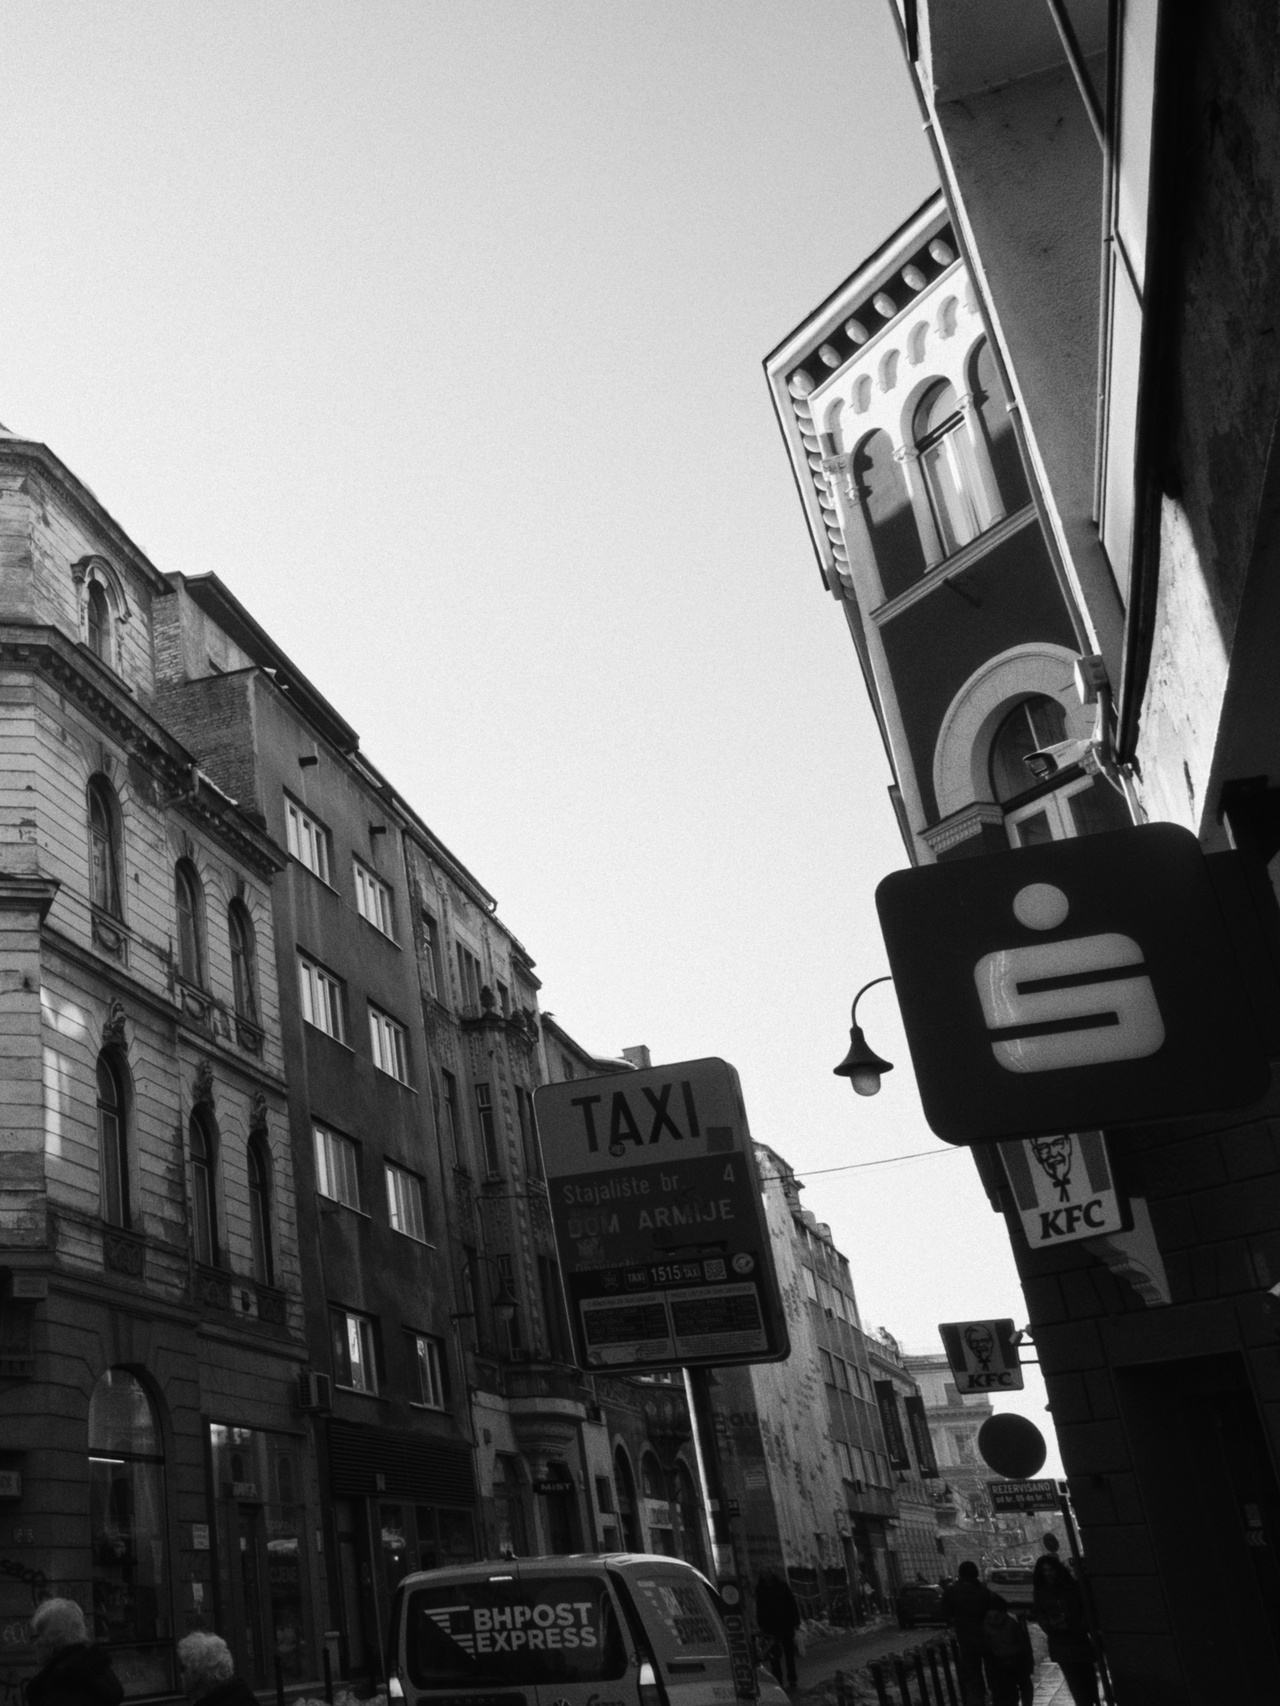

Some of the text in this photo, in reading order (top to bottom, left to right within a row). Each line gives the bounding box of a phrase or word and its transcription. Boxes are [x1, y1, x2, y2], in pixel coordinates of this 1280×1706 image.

[571, 1080, 701, 1153] TAXI
[562, 1177, 651, 1206] Stajalište
[723, 1163, 736, 1183] 4
[567, 1199, 736, 1239] DOM ARMIJE
[1039, 1199, 1106, 1240] KFC
[626, 1272, 646, 1284] TAXI
[651, 1264, 701, 1283] 1515 TAXI
[967, 1371, 1013, 1389] KFC
[540, 1482, 571, 1492] MIST
[991, 1481, 1052, 1495] REZERVISANO
[473, 1601, 593, 1632] BHPOST
[474, 1626, 598, 1654] EXPRESS
[725, 1616, 759, 1697] OMEGA
